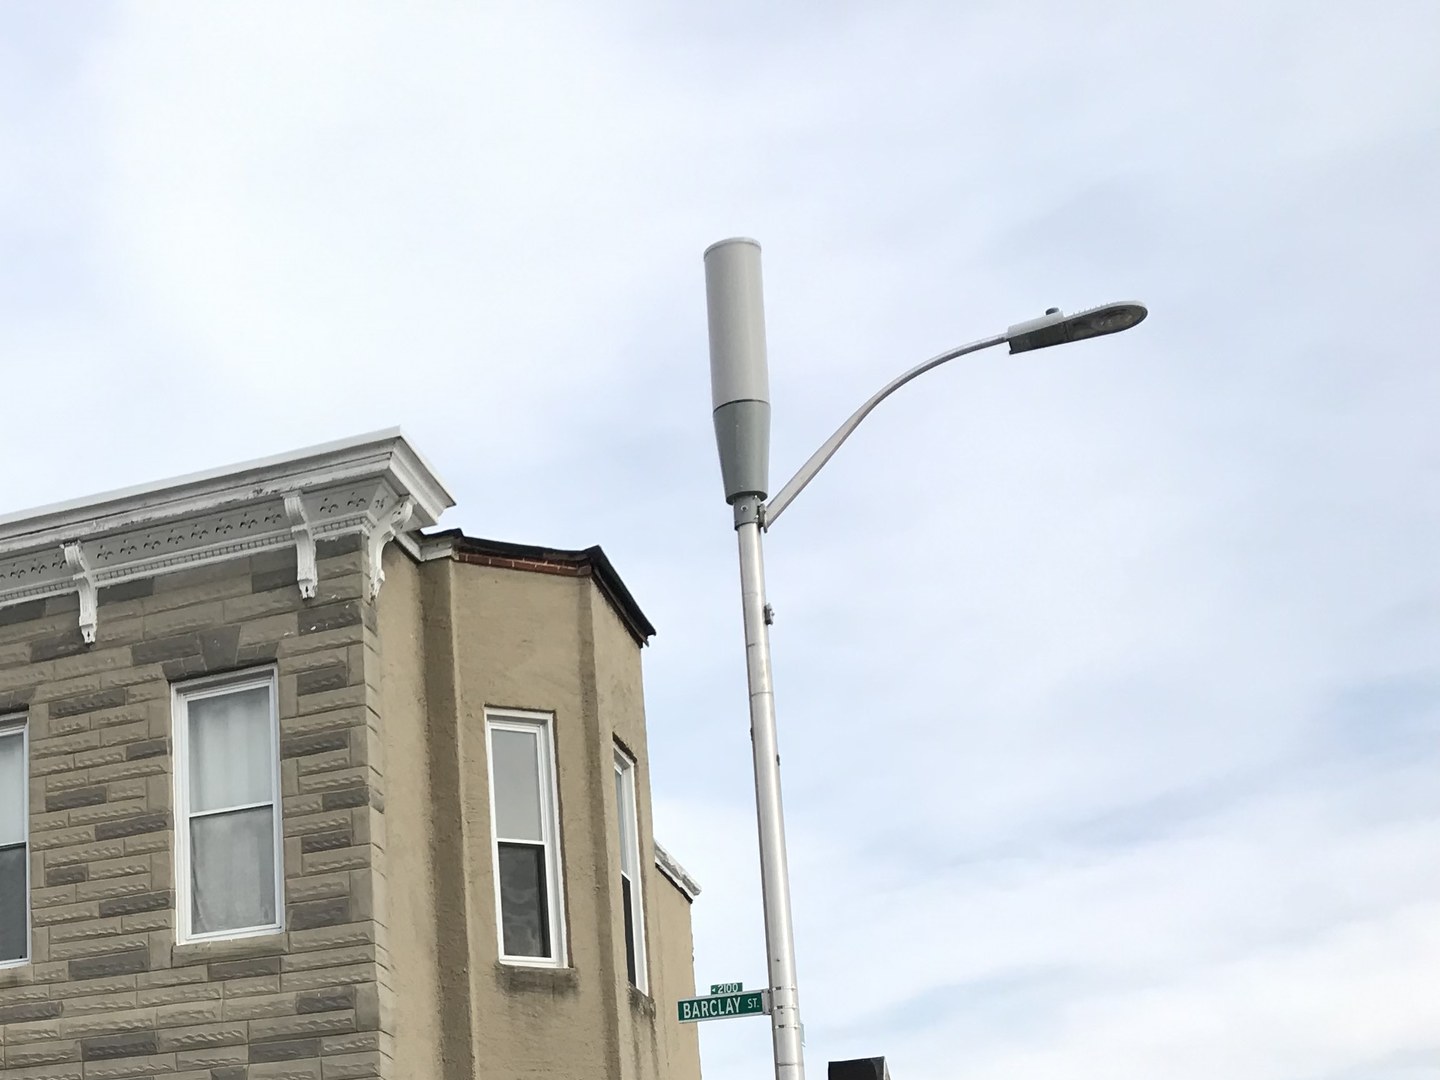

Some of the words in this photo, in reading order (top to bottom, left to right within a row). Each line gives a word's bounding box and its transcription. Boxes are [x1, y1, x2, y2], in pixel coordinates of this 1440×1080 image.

[717, 983, 739, 994] 2100
[683, 996, 741, 1019] BARCLAY
[747, 998, 760, 1009] ST.
